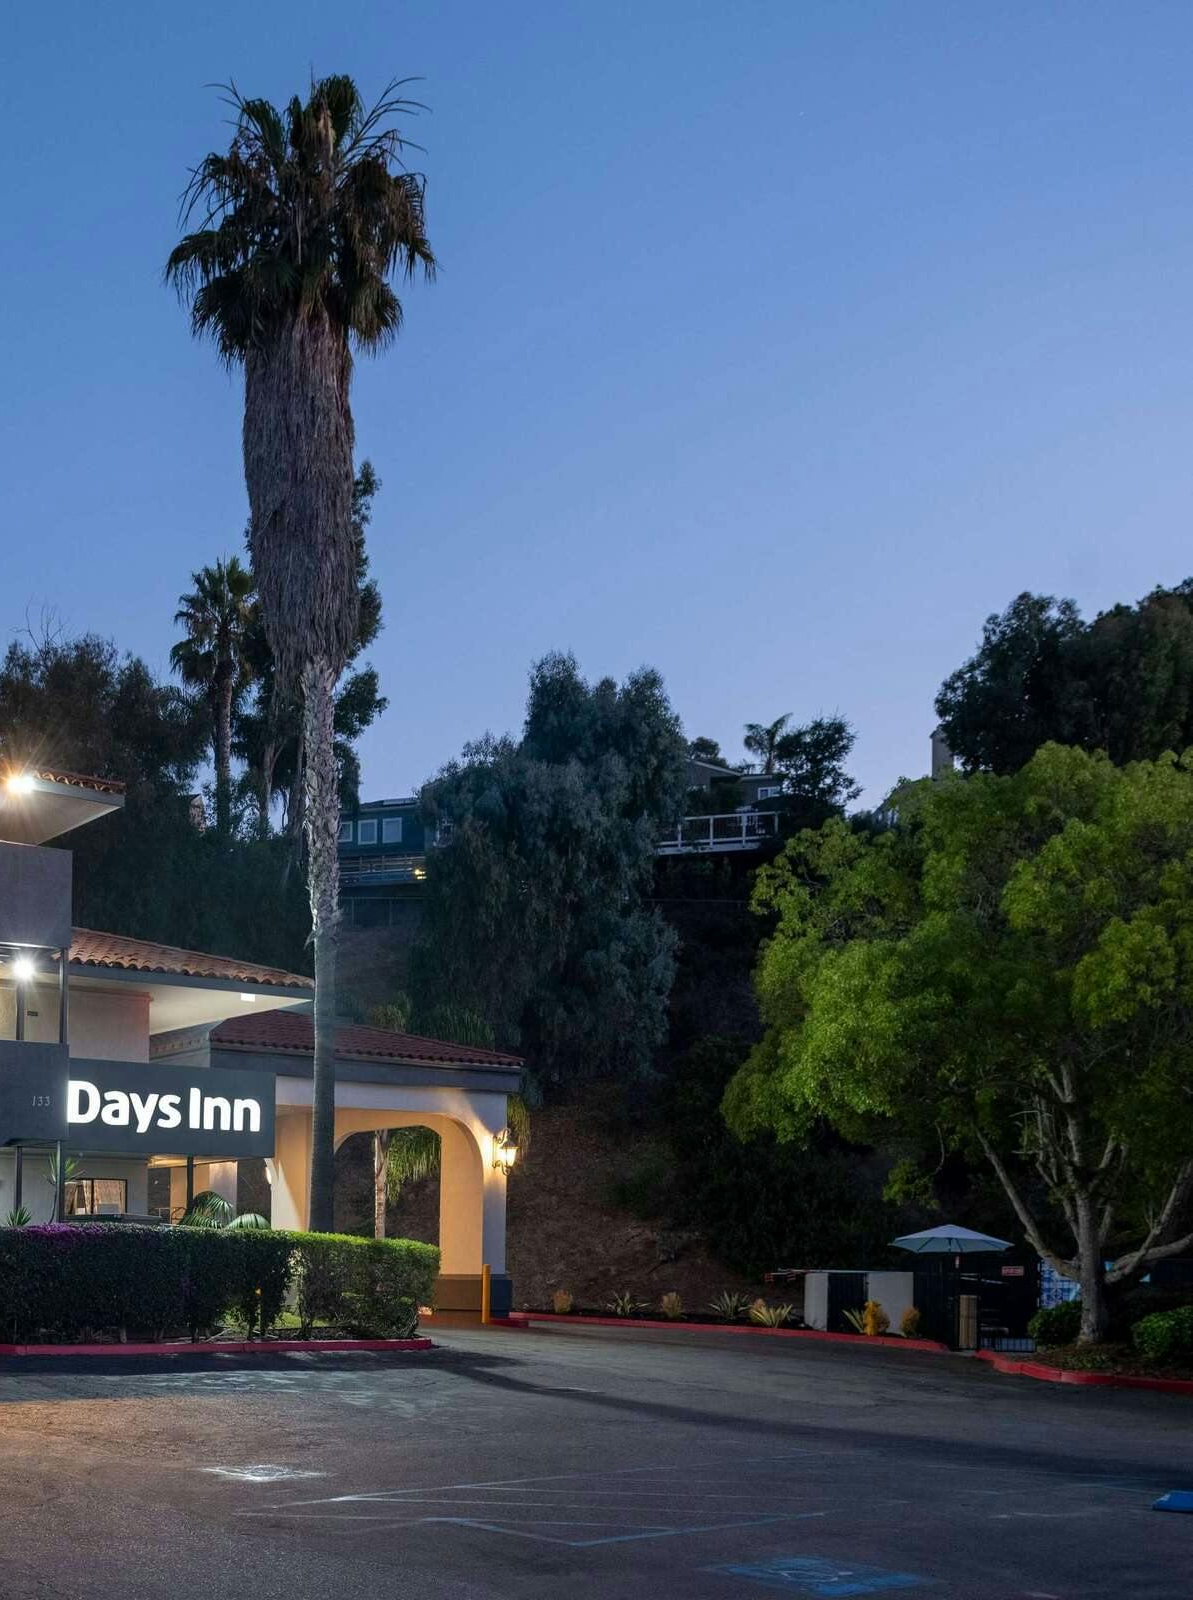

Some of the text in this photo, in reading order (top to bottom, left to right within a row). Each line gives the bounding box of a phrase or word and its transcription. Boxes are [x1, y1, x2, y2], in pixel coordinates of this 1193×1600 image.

[32, 1095, 50, 1106] 133
[66, 1080, 261, 1133] Days Inn
